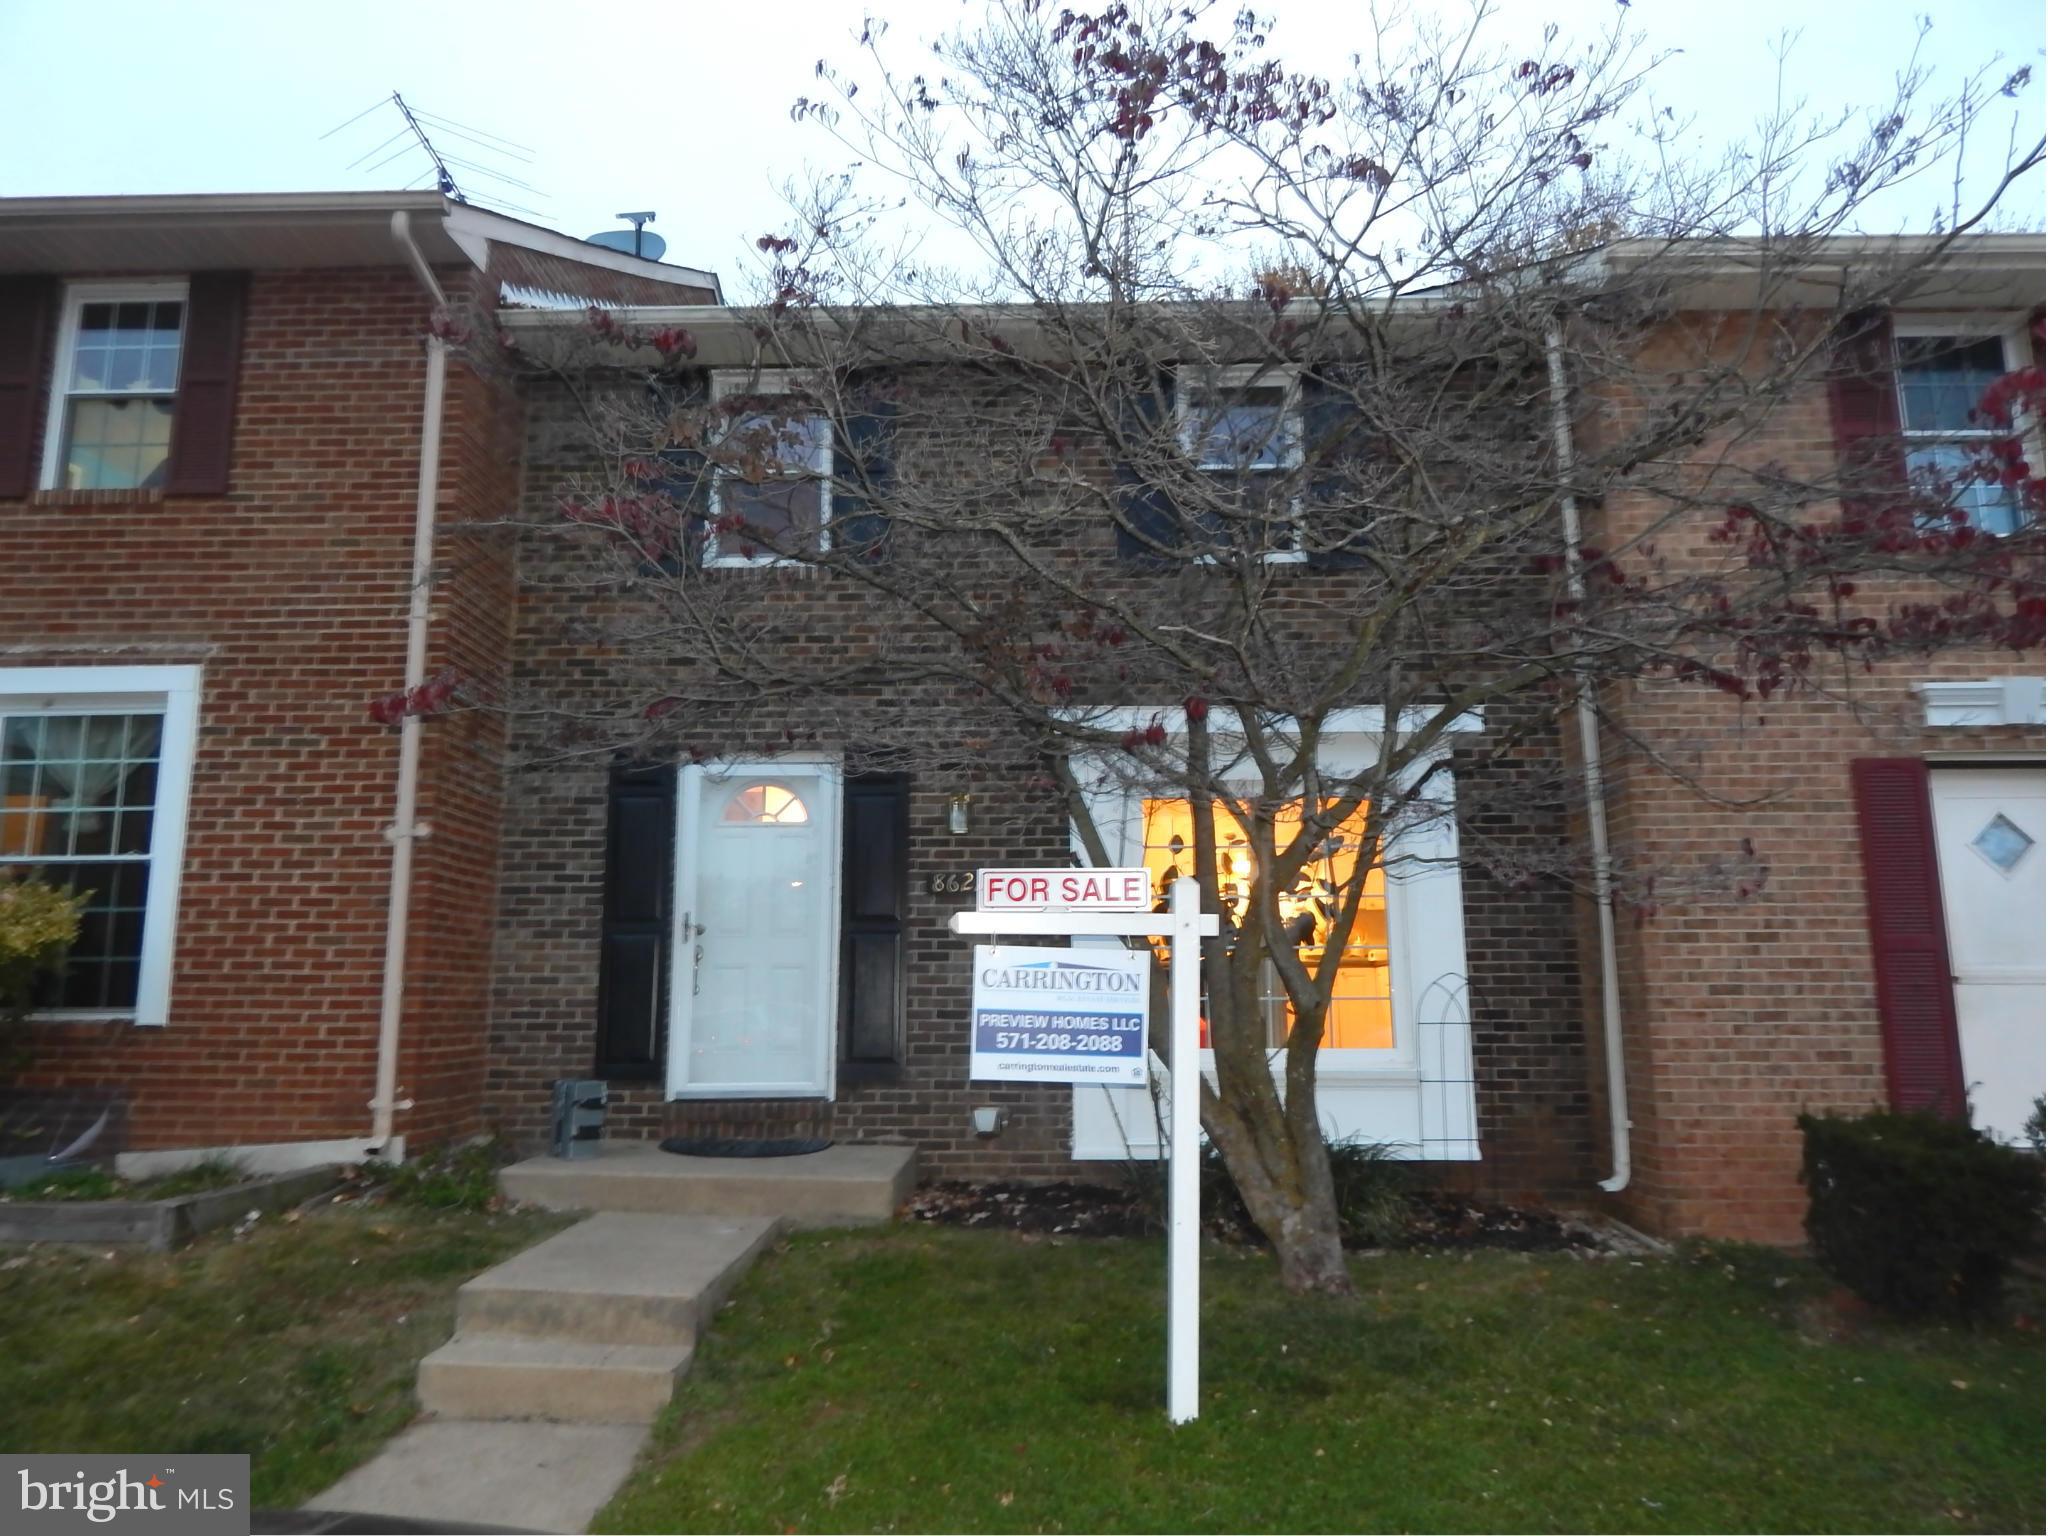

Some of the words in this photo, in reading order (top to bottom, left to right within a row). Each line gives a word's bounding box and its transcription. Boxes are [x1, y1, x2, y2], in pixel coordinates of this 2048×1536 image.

[931, 871, 976, 894] 862
[987, 877, 1050, 902] FOR
[1062, 877, 1142, 902] SALE
[981, 967, 1142, 992] CARRINGTON
[979, 1013, 1050, 1028] PREVIEW
[1051, 1015, 1109, 1030] HOMES
[1111, 1018, 1141, 1031] LLC
[996, 1032, 1123, 1052] 571-208-2088
[998, 1062, 1120, 1073] carringtonrealestate.com
